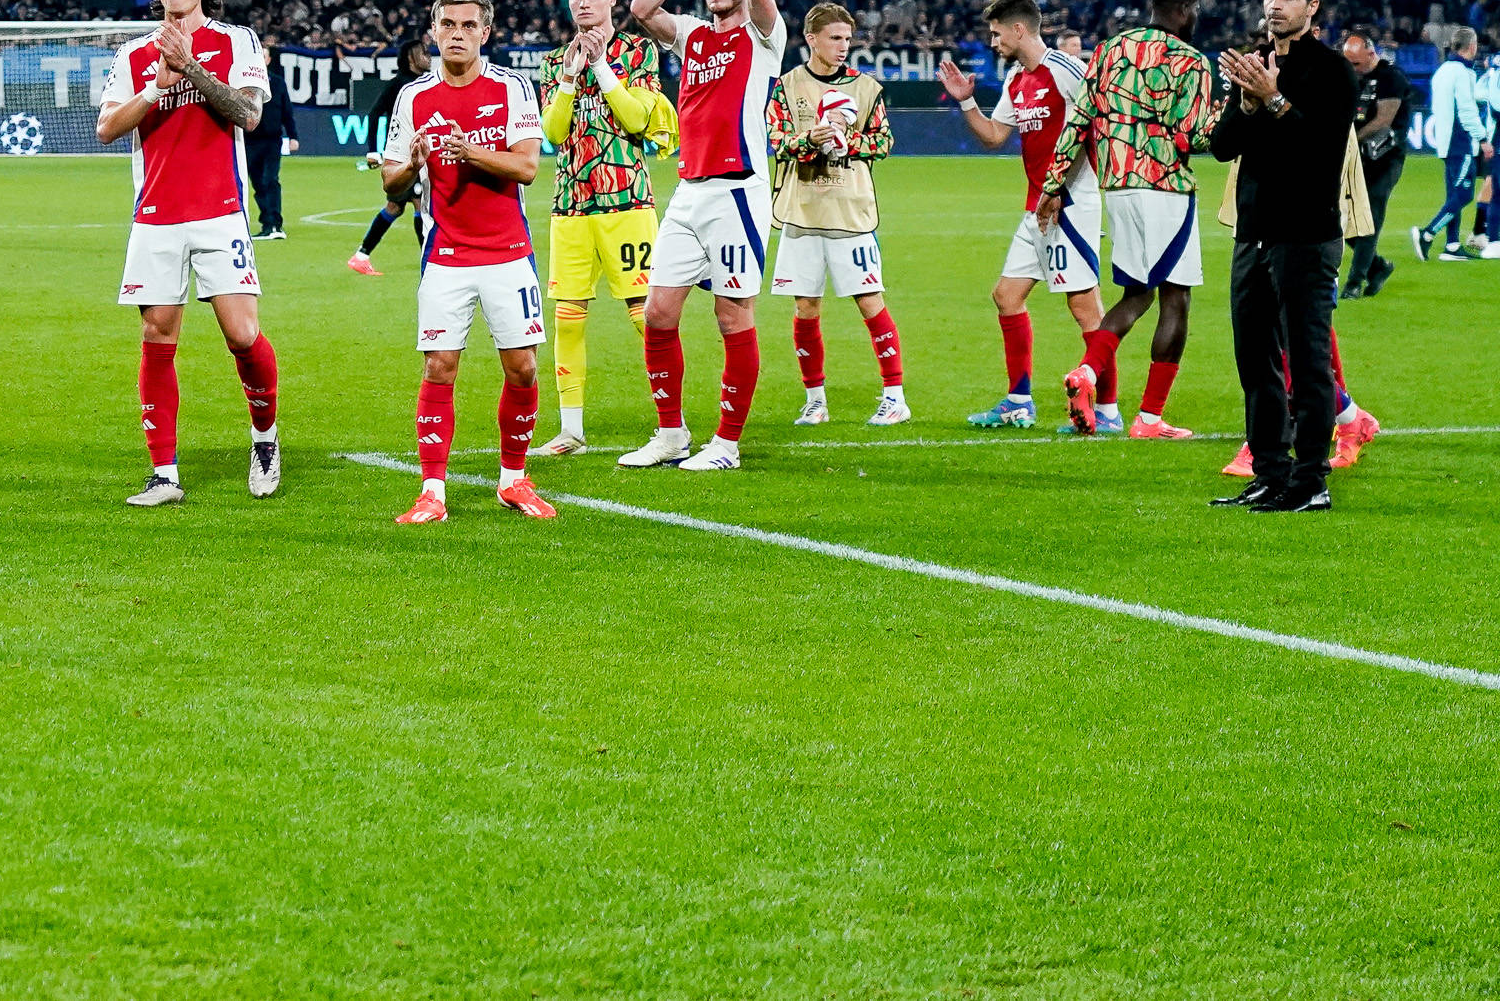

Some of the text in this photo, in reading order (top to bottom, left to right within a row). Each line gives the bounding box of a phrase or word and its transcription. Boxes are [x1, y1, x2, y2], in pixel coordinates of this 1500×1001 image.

[158, 95, 175, 111] FLY
[621, 242, 651, 272] 92
[720, 244, 747, 274] 41
[852, 246, 879, 272] 44
[1046, 244, 1067, 271] 20
[517, 285, 541, 320] 19
[417, 415, 443, 424] AFC
[515, 409, 538, 423] AFC
